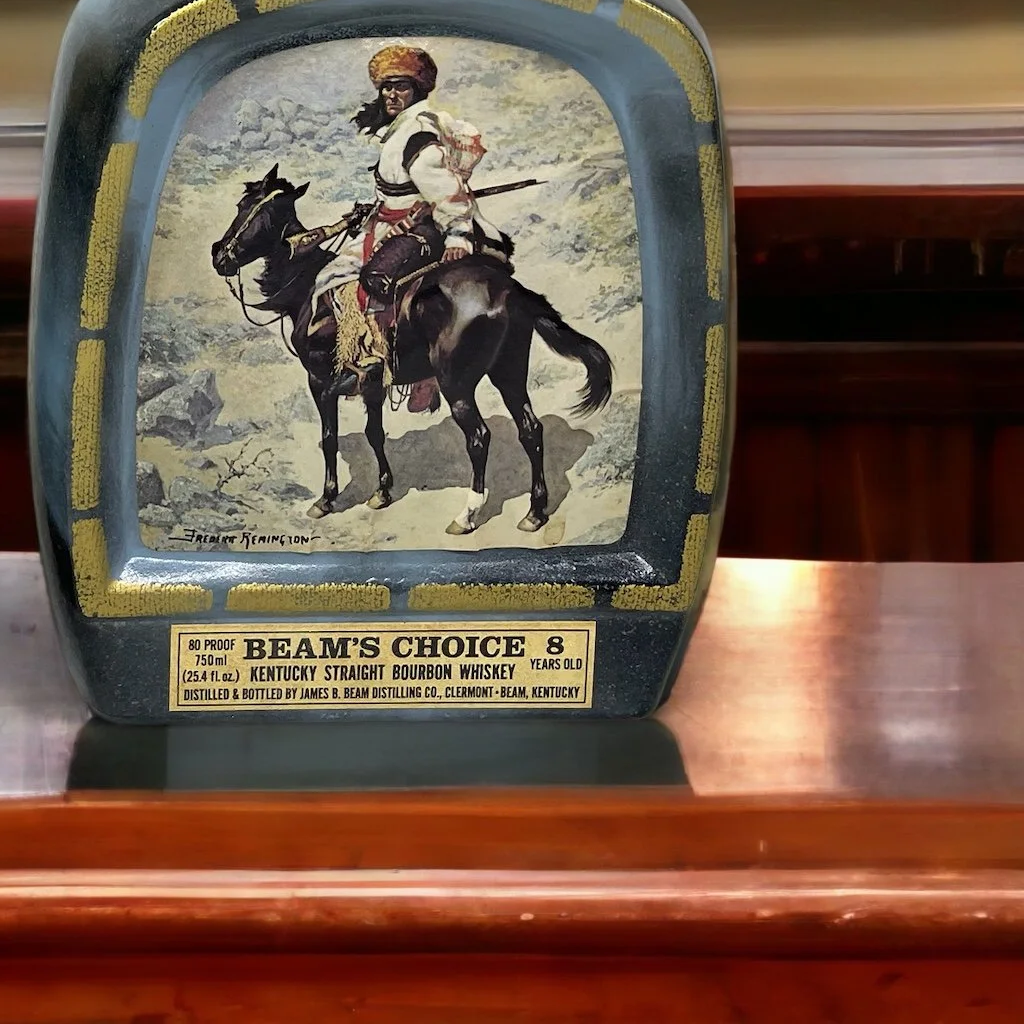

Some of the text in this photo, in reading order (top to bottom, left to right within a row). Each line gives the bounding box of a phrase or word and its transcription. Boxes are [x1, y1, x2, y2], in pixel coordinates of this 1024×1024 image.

[188, 639, 236, 651] 80 PROOF
[243, 635, 526, 659] BEAM'S CHOICE
[546, 635, 565, 655] 8
[530, 658, 583, 670] YEARS OLD
[182, 669, 208, 684] (25.4
[250, 663, 516, 682] KENTUCKY STRAIGHT BOURBON WHISKEY
[183, 689, 229, 701] DISTILLED
[232, 689, 240, 700] &
[242, 688, 283, 700] BOTTLED
[285, 688, 297, 700] BY
[299, 688, 329, 700] JAMES
[332, 688, 341, 699] B.
[343, 687, 370, 699] BEAM
[372, 687, 422, 699] DISTILLING
[531, 686, 580, 699] KENTUCKY
